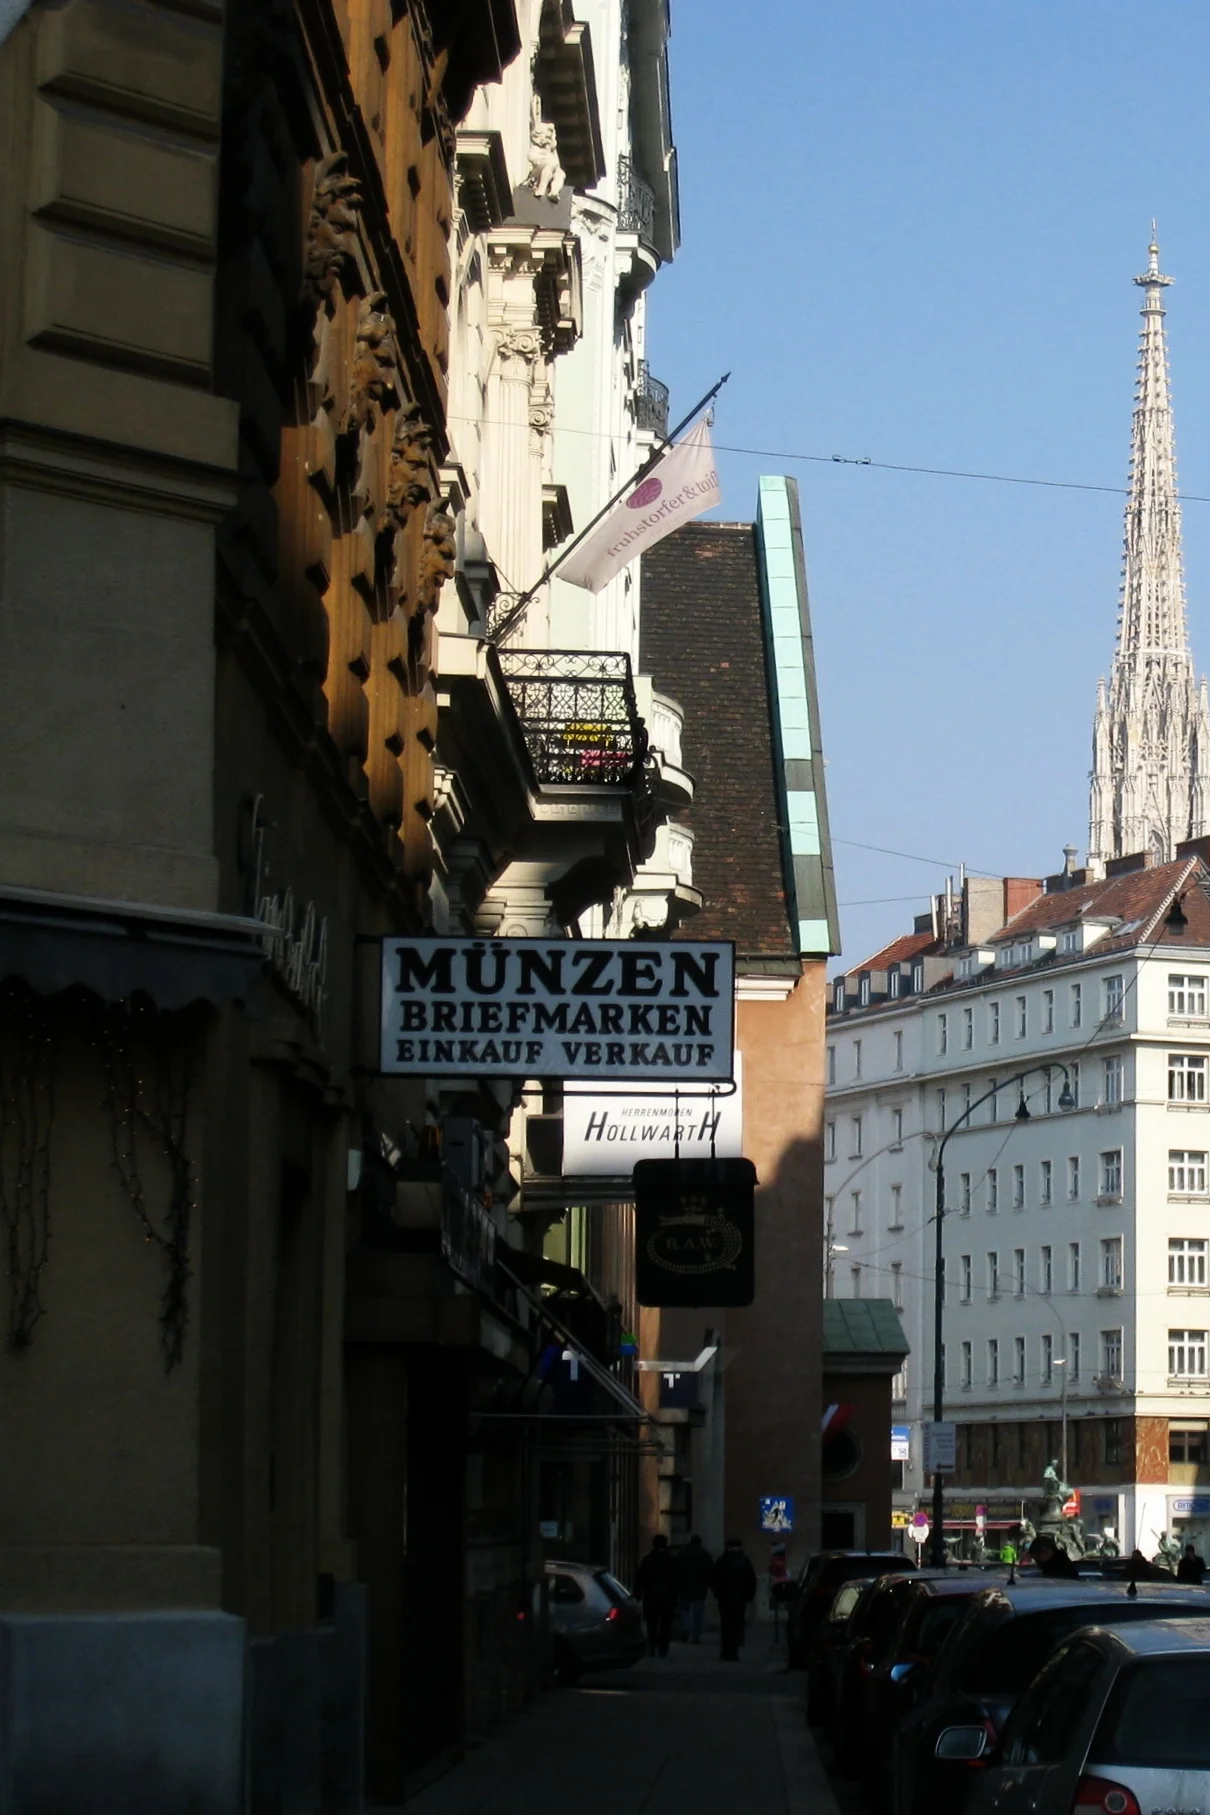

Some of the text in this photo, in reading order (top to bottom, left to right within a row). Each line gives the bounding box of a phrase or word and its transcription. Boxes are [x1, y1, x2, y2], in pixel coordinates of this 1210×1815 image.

[395, 943, 720, 997] MÜNZEN
[400, 1001, 713, 1036] BRIEFMARKEN
[396, 1040, 715, 1067] EINKAUF VERKAUF
[621, 1108, 693, 1118] HERRENMODEN
